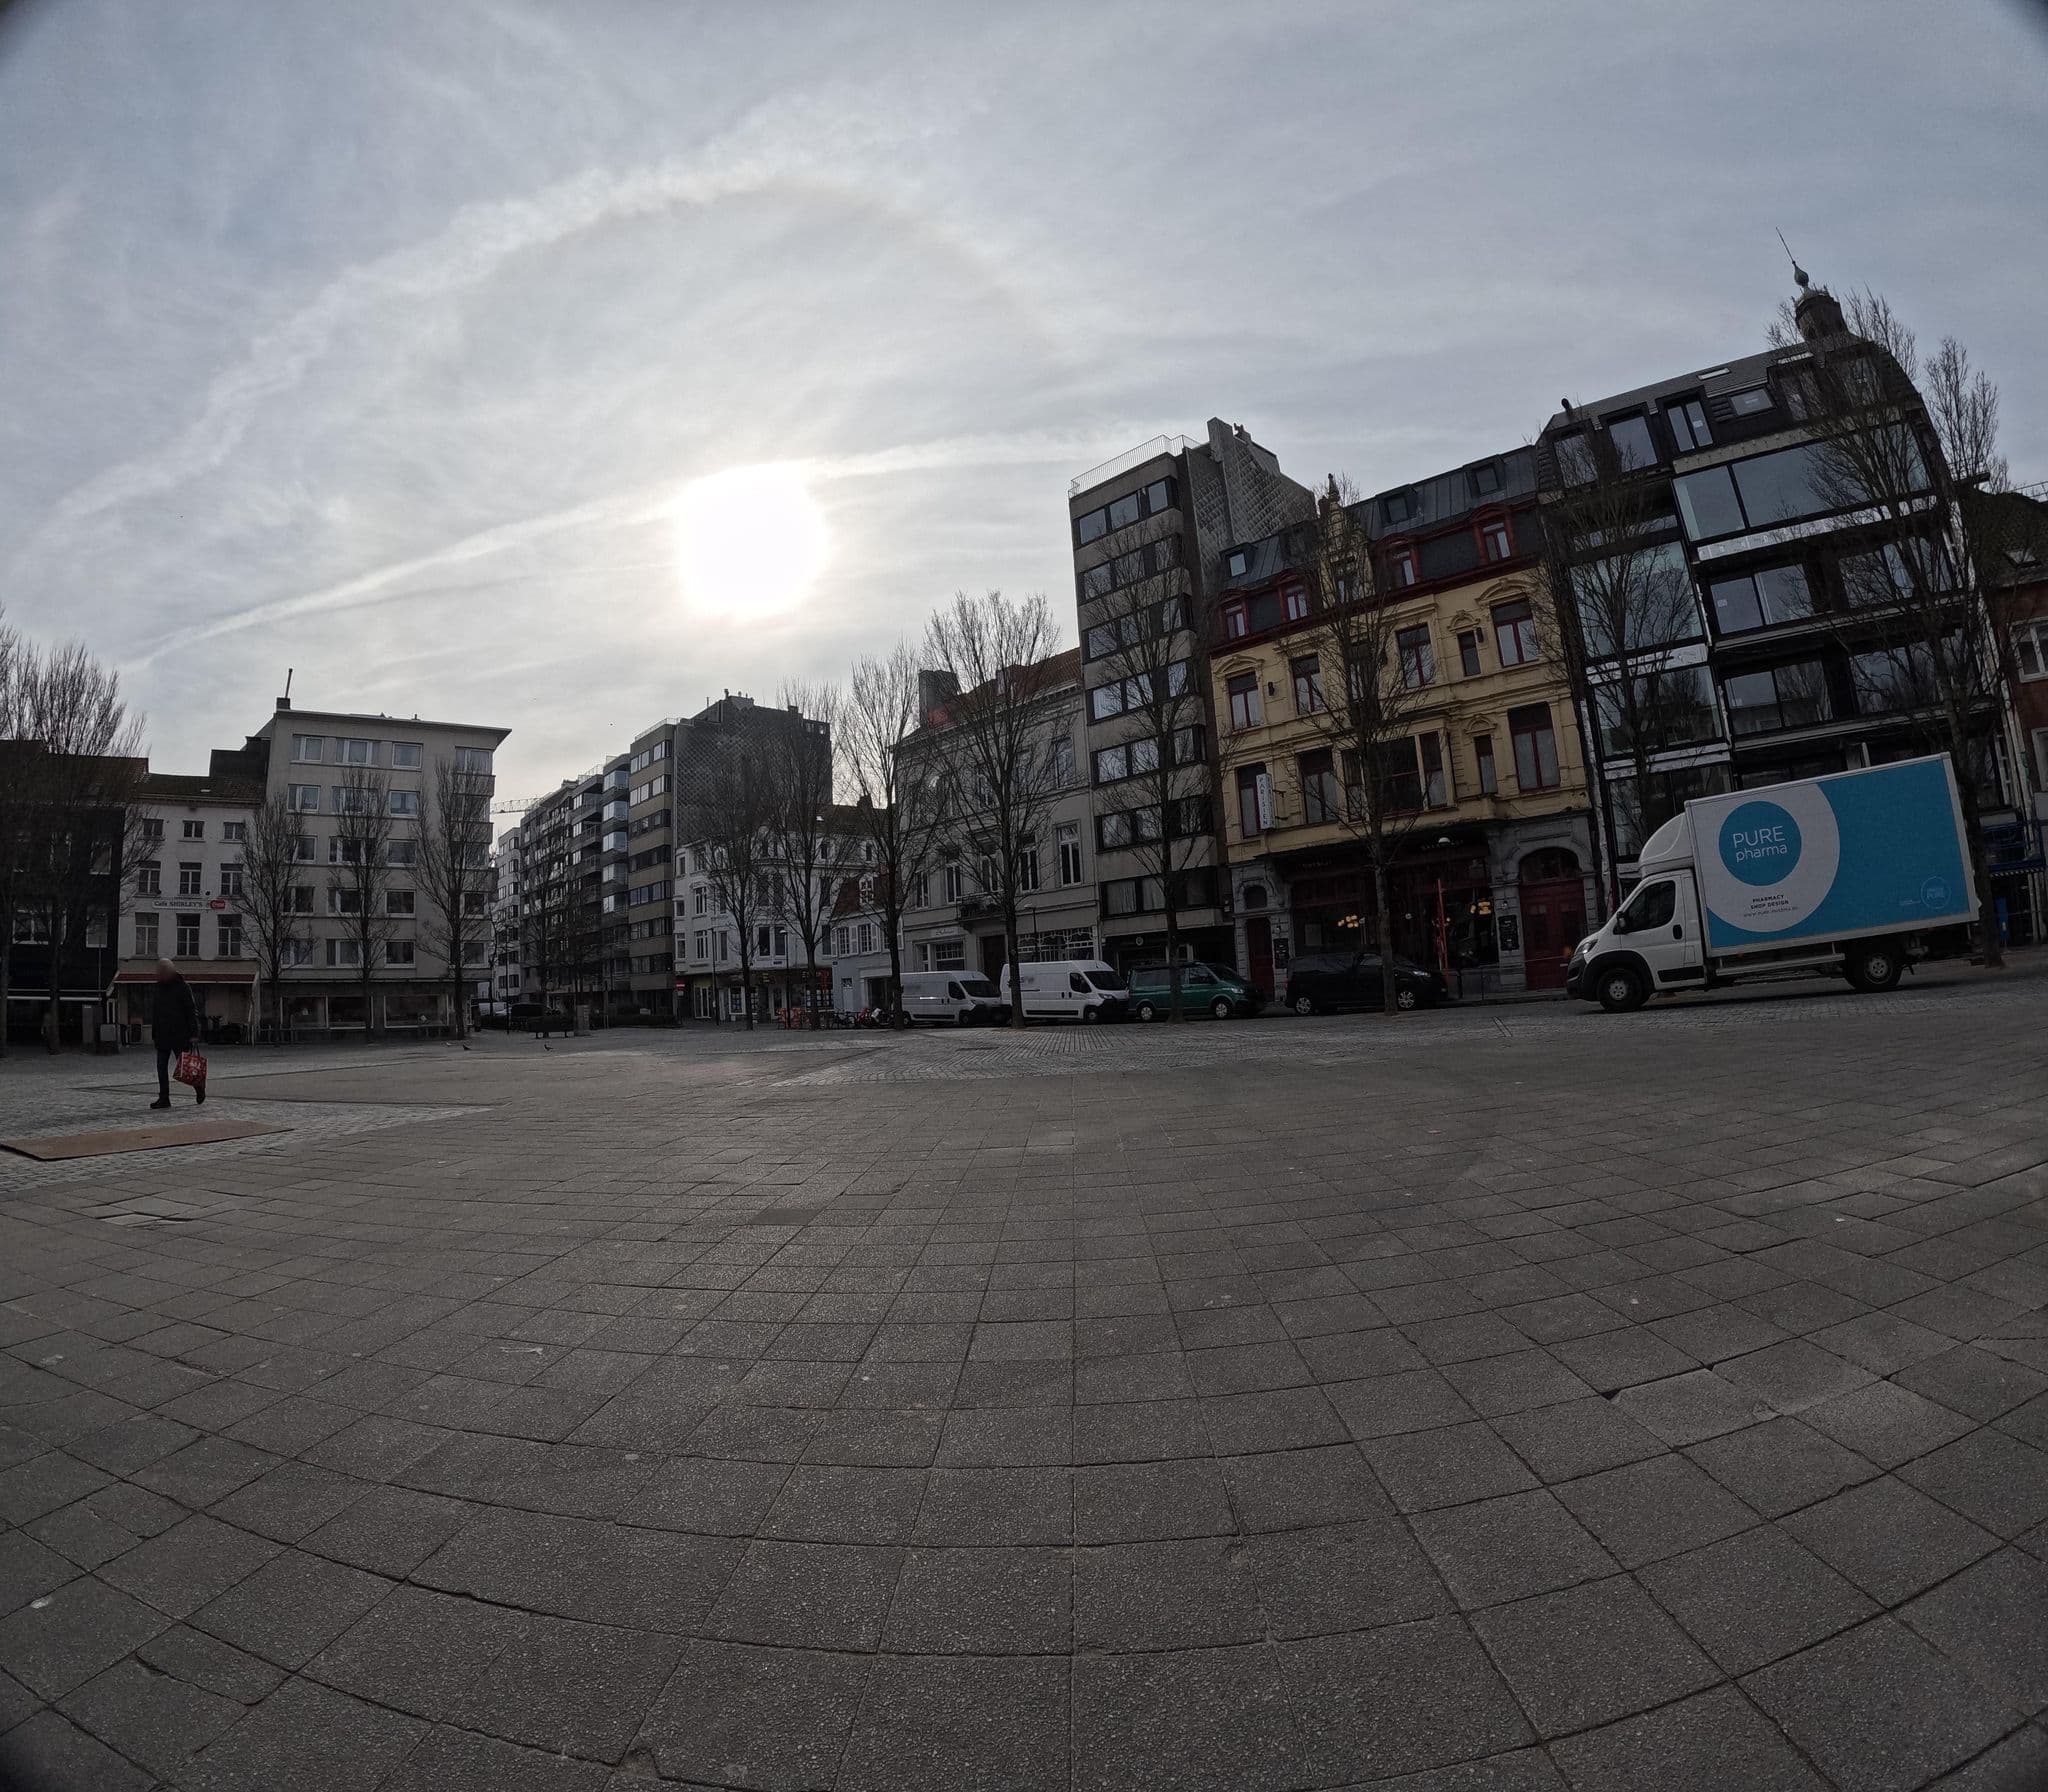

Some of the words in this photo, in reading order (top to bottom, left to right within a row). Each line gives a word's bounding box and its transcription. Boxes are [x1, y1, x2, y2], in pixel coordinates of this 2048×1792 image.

[1733, 825, 1786, 849] PURE
[1736, 844, 1788, 863] pharma
[1752, 894, 1784, 903] PHARMACY
[1767, 899, 1789, 908] DESIGN
